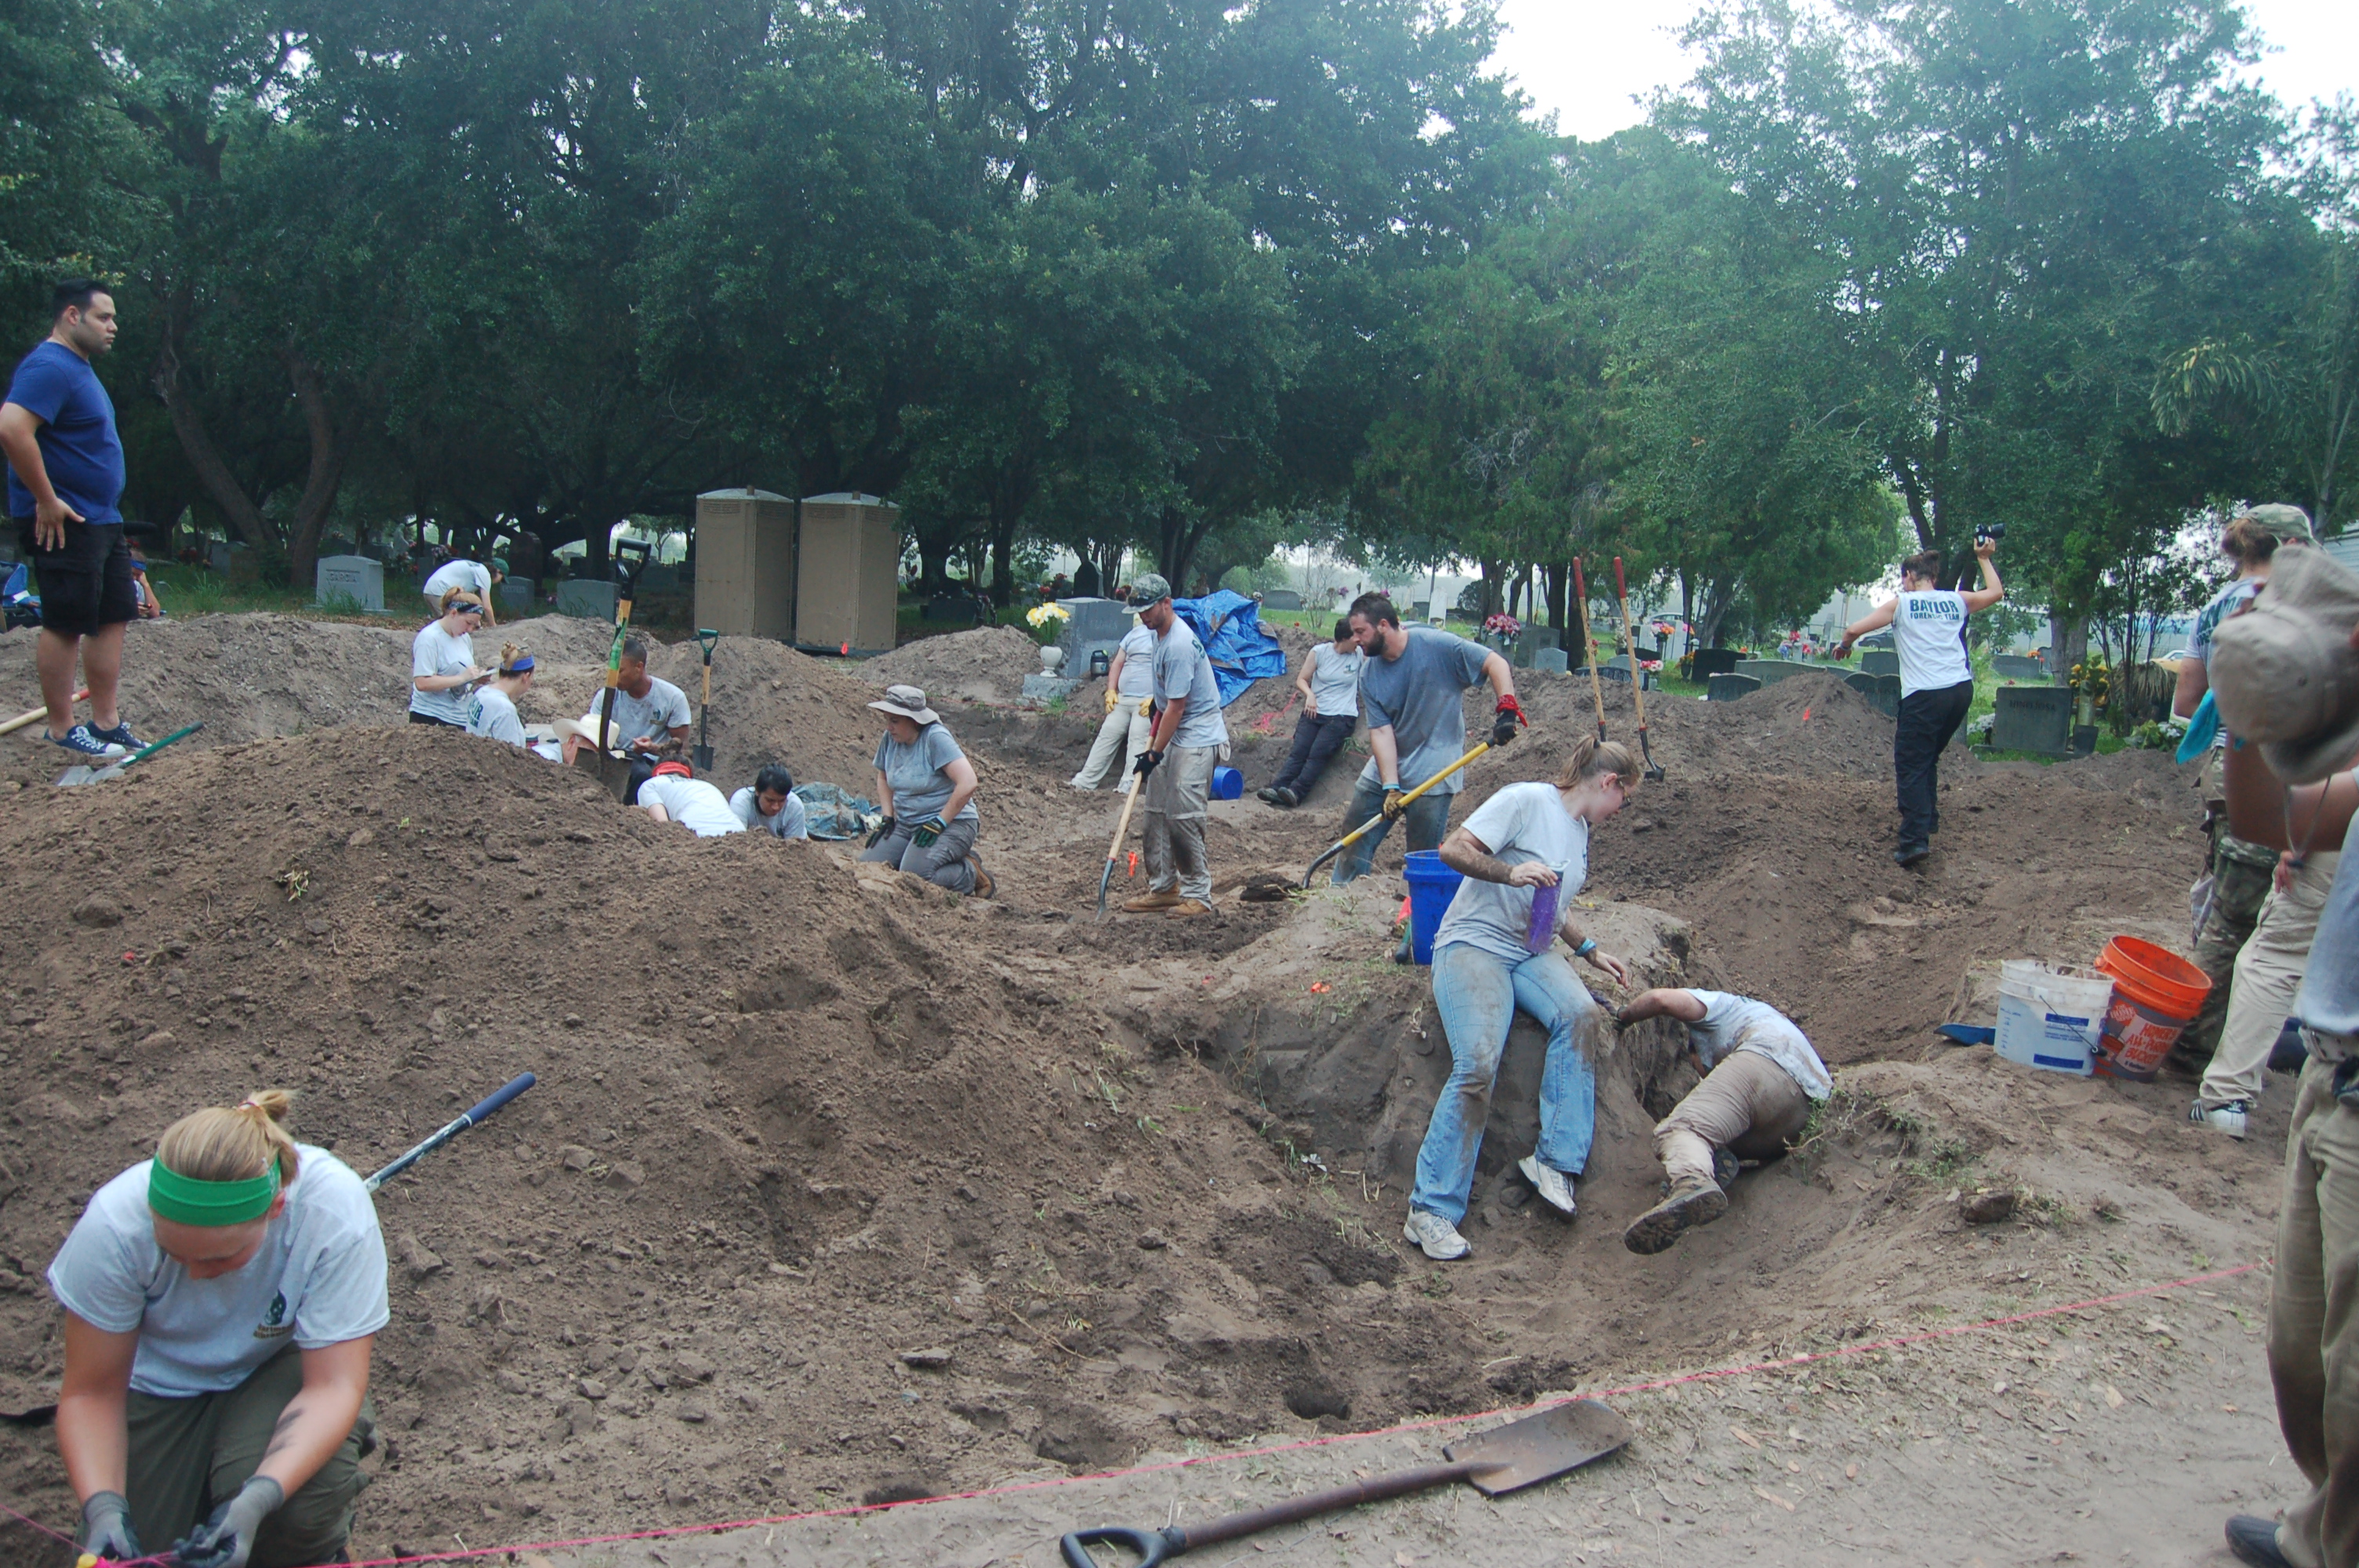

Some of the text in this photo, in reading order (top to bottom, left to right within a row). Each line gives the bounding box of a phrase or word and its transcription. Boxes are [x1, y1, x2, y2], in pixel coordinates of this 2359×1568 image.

[329, 572, 358, 583] GARCIA
[1910, 599, 1959, 614] BAYLOR
[2009, 699, 2056, 712] HINOJOSA
[2110, 1006, 2135, 1019] HOME
[2125, 1047, 2158, 1065] BUCKET
